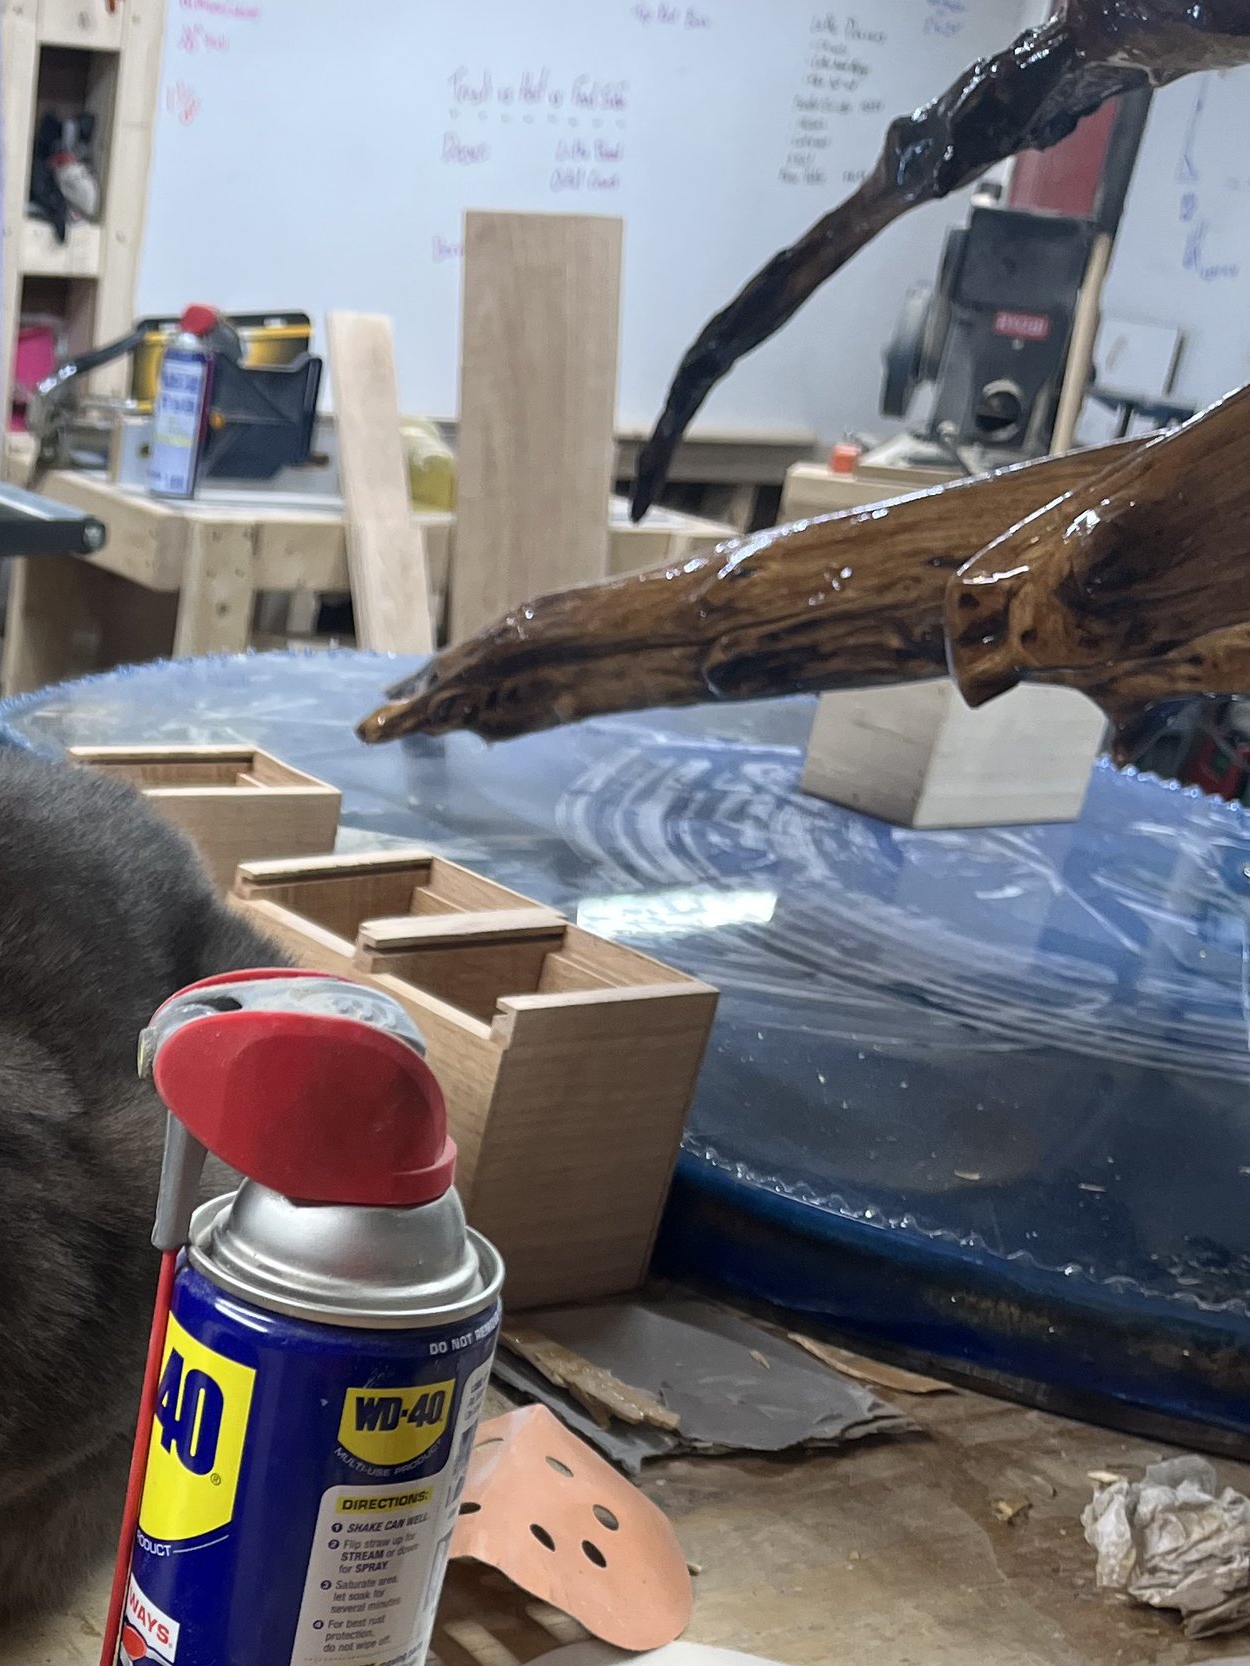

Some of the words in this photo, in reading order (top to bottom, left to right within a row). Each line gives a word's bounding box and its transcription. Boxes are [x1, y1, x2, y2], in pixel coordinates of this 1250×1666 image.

[429, 1342, 447, 1355] DO
[452, 1333, 472, 1349] NOT
[355, 1390, 446, 1432] WD-40
[334, 1447, 390, 1477] MULTI-USE
[393, 1441, 441, 1475] PRODUCT
[341, 1490, 429, 1511] DIRECTIONS:
[347, 1522, 383, 1534] SHAKE
[384, 1518, 404, 1531] CAN
[343, 1538, 361, 1551] Flip
[363, 1538, 391, 1550] straw
[392, 1536, 404, 1547] up
[341, 1549, 385, 1562] STREAM
[385, 1549, 395, 1558] or
[338, 1563, 352, 1574] for
[335, 1578, 377, 1590] Saturate
[333, 1592, 347, 1602] let
[349, 1589, 372, 1601] soak
[373, 1588, 386, 1598] for
[330, 1602, 366, 1614] several
[327, 1618, 344, 1629] For
[345, 1616, 367, 1628] best
[368, 1614, 387, 1626] rust
[323, 1641, 337, 1653] do
[338, 1640, 355, 1652] not
[356, 1637, 378, 1651] wipe
